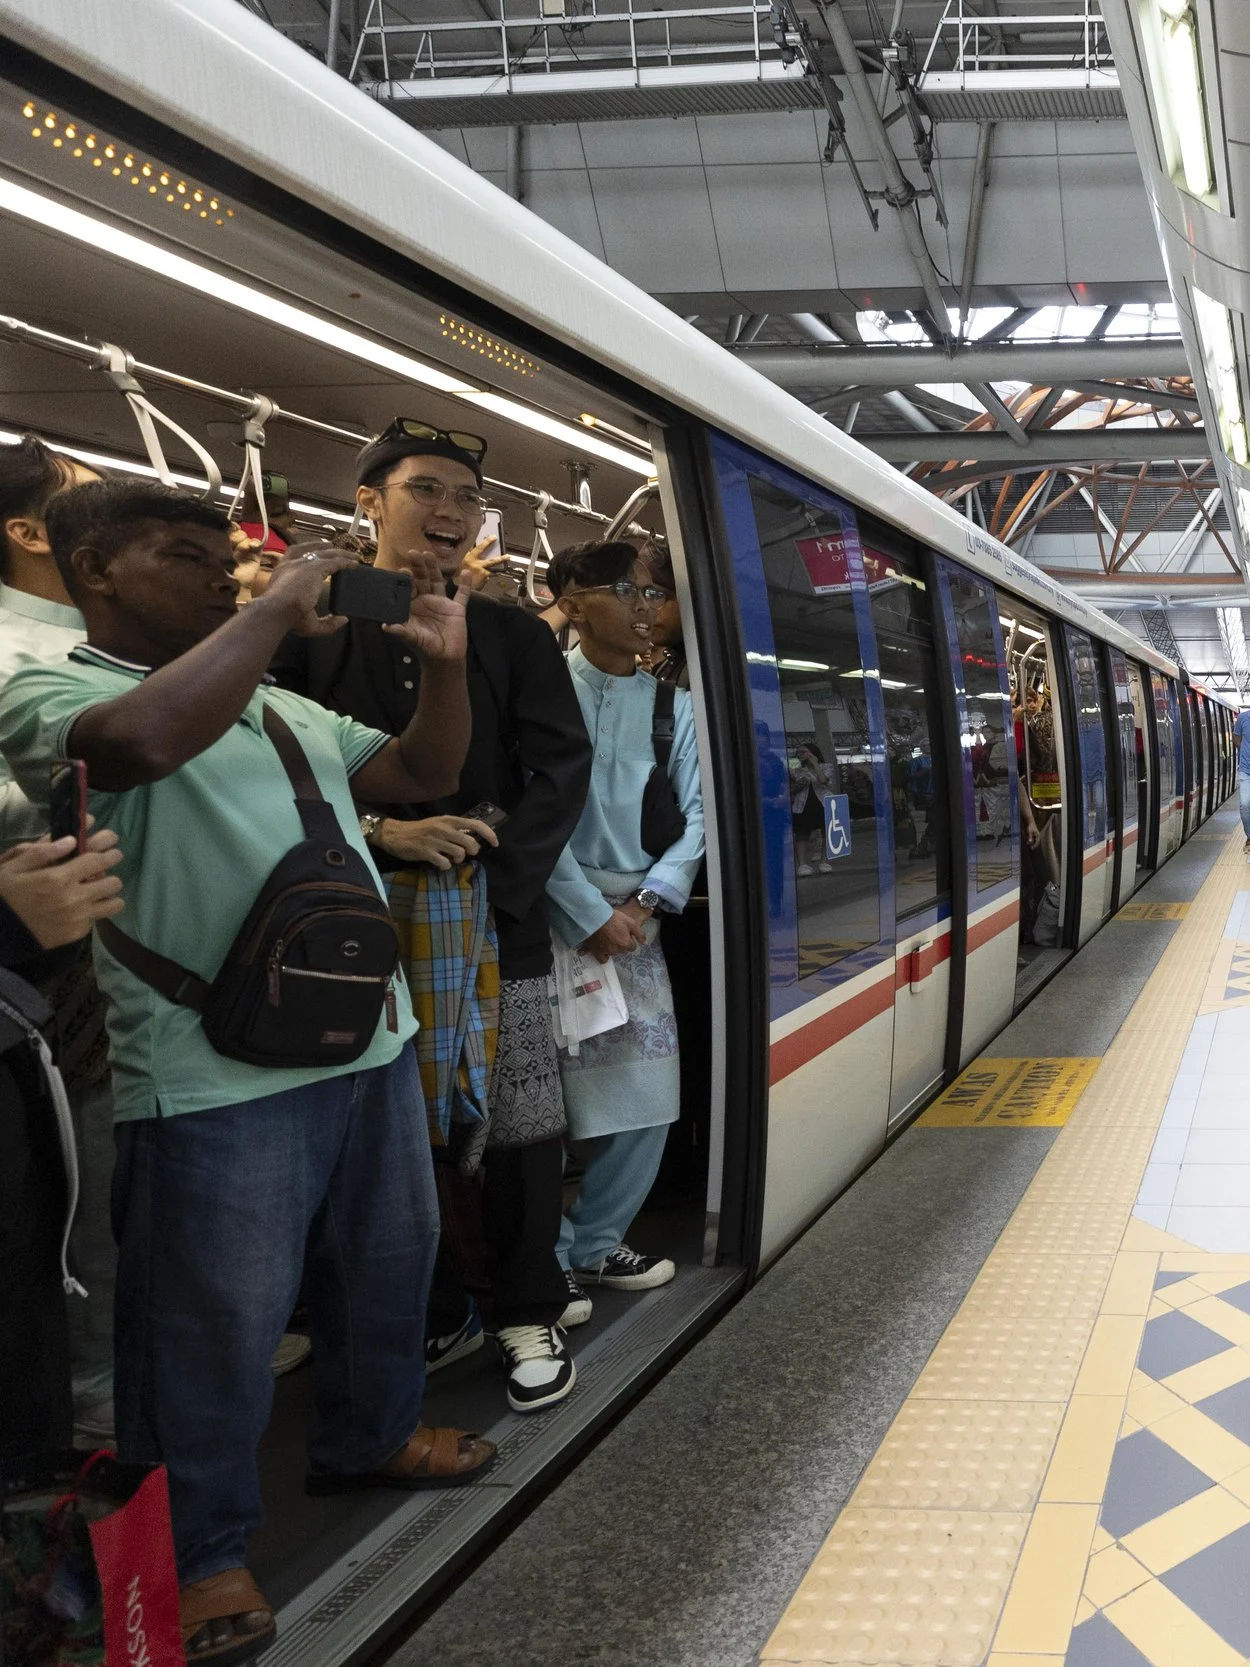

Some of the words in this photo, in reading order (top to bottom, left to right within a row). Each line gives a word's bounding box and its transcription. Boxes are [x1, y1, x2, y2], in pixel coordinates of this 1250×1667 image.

[941, 1071, 999, 1107] AWAS
[997, 1062, 1064, 1119] CAUTION
[126, 1575, 151, 1667] KSON
